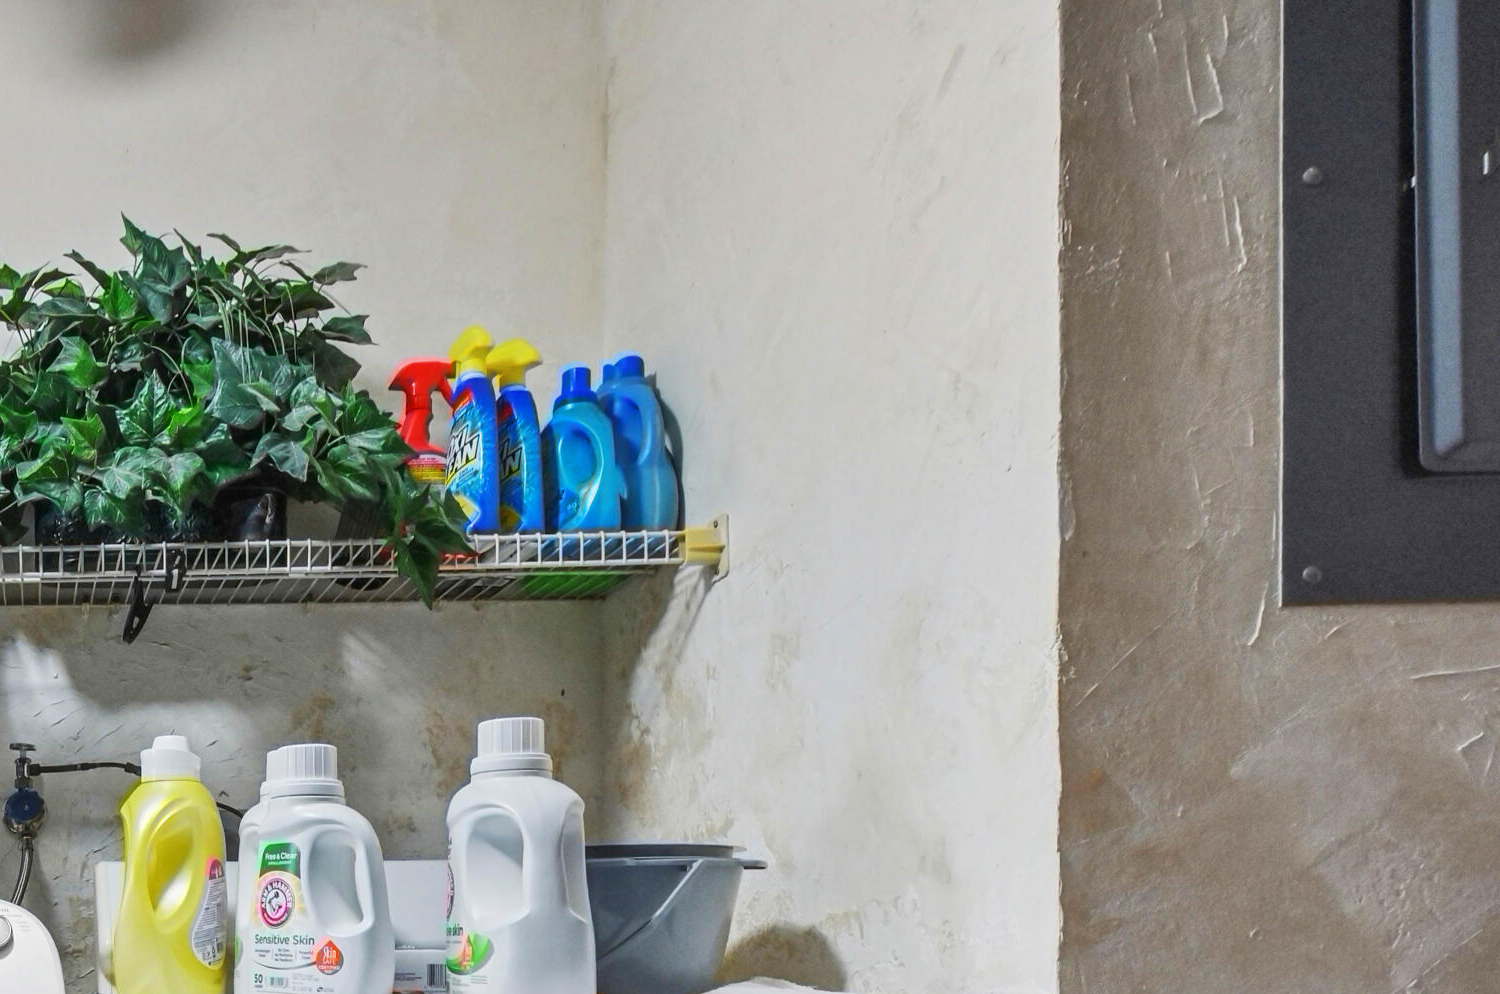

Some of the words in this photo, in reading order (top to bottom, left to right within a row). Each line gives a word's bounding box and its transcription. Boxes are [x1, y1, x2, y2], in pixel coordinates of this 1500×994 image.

[280, 852, 298, 860] Clear
[272, 880, 293, 908] HAMMER
[453, 923, 463, 938] skin
[255, 934, 290, 945] Sensitive
[292, 935, 315, 945] Skin
[323, 946, 337, 960] Skin
[254, 973, 263, 983] 50
